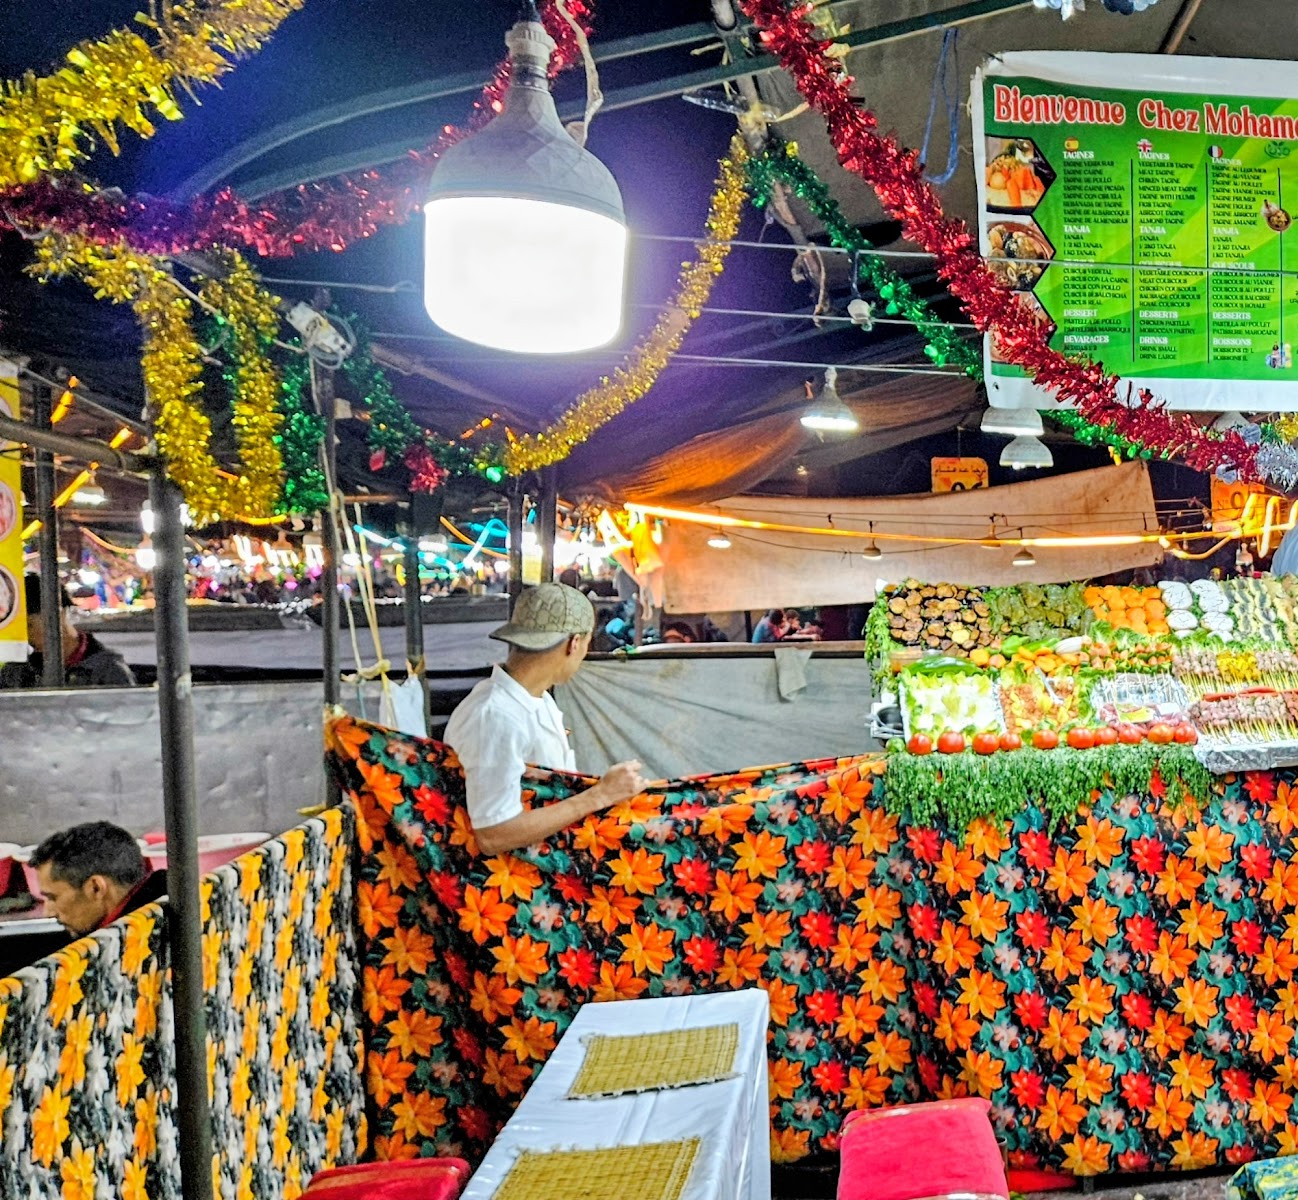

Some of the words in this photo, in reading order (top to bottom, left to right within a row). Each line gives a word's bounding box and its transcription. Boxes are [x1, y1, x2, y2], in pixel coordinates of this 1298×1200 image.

[994, 85, 1125, 125] Bienvenue
[1138, 99, 1199, 132] Chez
[1139, 151, 1169, 160] TAGINES
[1212, 156, 1241, 165] TAGINES
